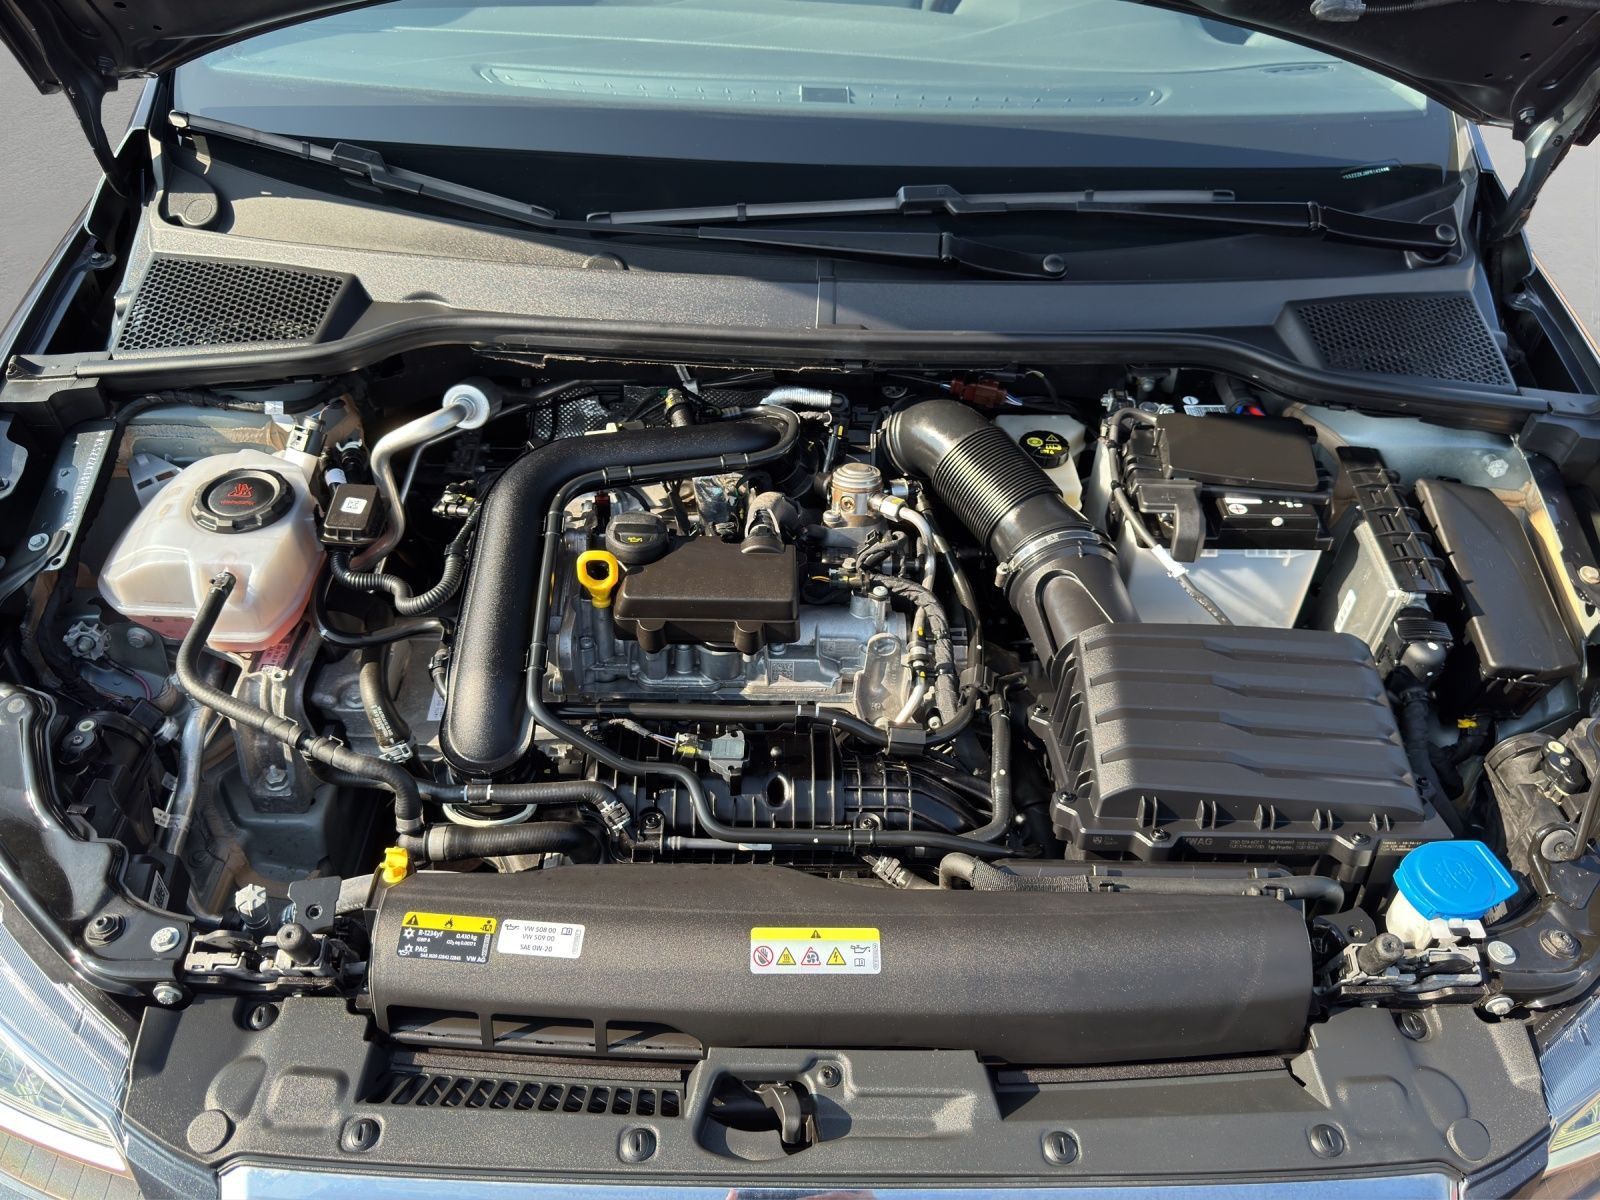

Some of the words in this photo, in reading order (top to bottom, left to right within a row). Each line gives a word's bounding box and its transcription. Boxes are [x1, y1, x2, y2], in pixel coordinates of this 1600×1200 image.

[418, 929, 444, 939] R-1234yf
[415, 945, 428, 953] PAG
[531, 944, 553, 952] 0W-20
